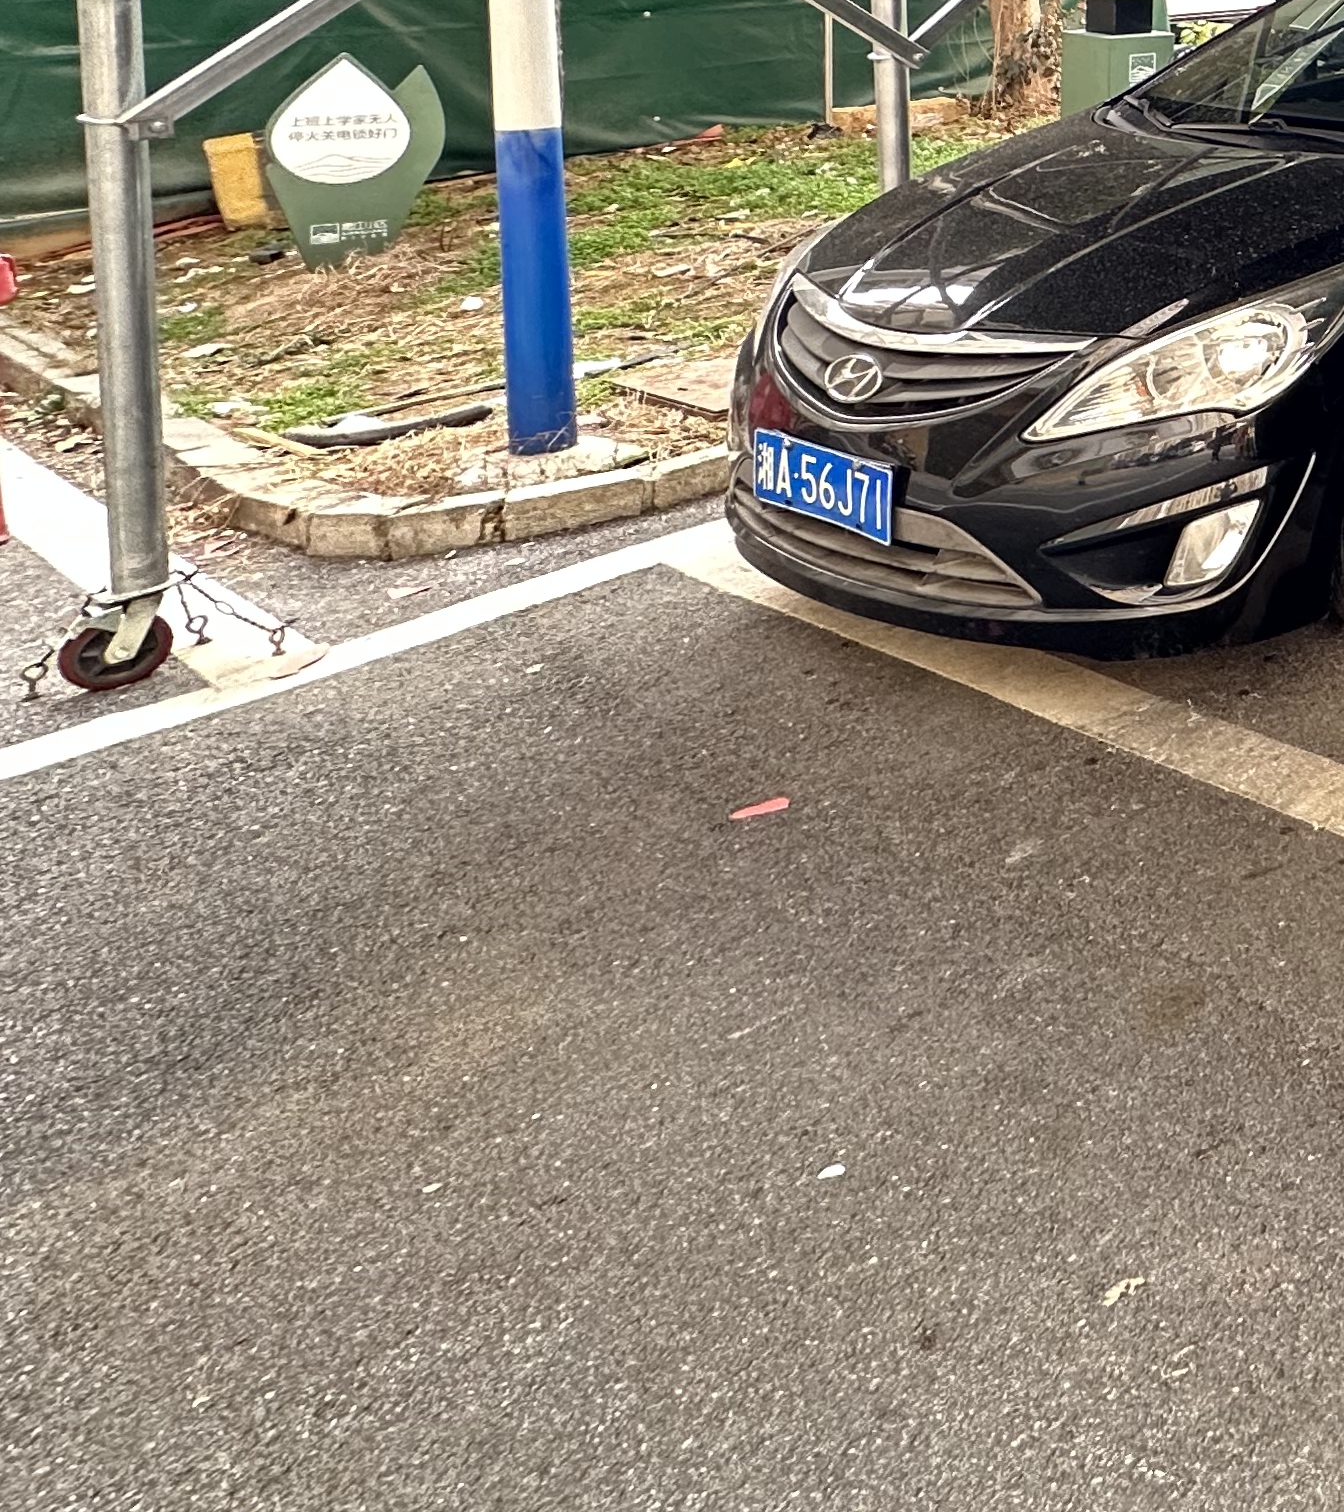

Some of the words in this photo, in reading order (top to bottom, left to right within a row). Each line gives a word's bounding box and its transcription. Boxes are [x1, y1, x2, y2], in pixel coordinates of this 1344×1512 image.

[290, 113, 398, 127] 上班上学家无人
[288, 128, 398, 142] 停火关电锁好门
[757, 442, 882, 530] 湘A·56J71
